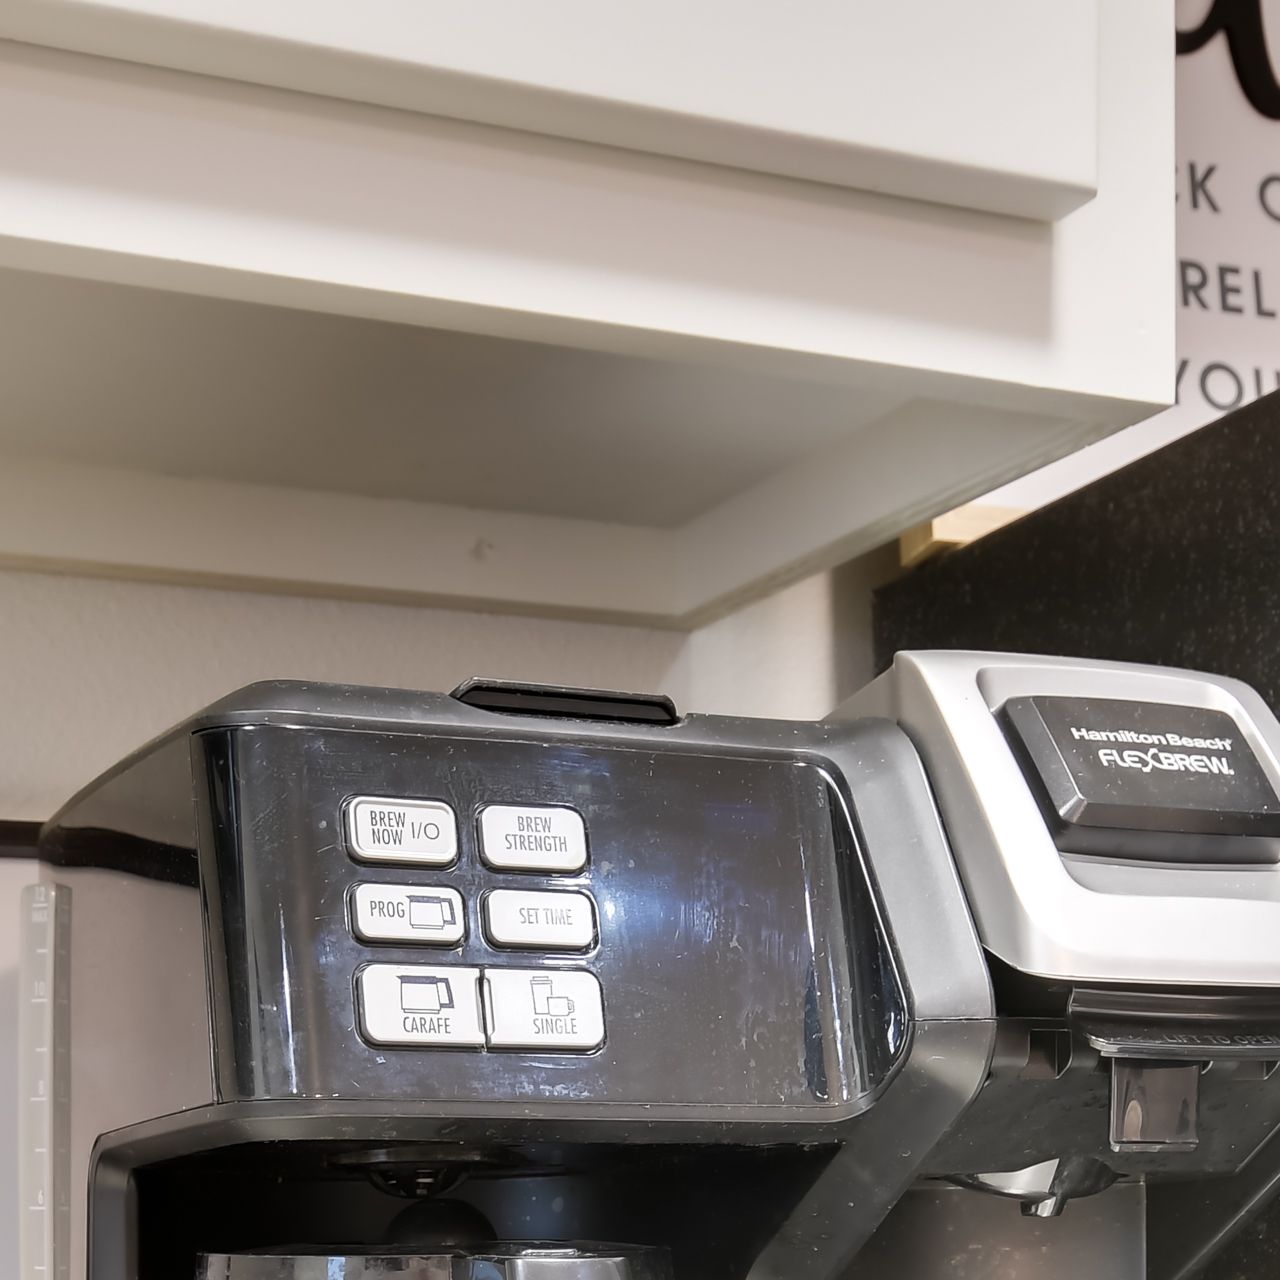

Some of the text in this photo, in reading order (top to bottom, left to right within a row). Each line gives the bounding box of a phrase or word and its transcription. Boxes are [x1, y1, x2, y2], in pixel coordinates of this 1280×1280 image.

[1070, 727, 1167, 746] Hamilton
[369, 809, 406, 828] BREW
[517, 815, 552, 833] BREW
[371, 827, 403, 846] NOW
[504, 833, 568, 853] STRENGTH
[369, 900, 406, 919] PROG
[518, 907, 574, 926] SET TIME
[402, 1016, 452, 1035] CARAFE
[533, 1017, 578, 1036] SINGLE
[1162, 1033, 1201, 1043] LIFT
[1203, 1034, 1231, 1044] TO
